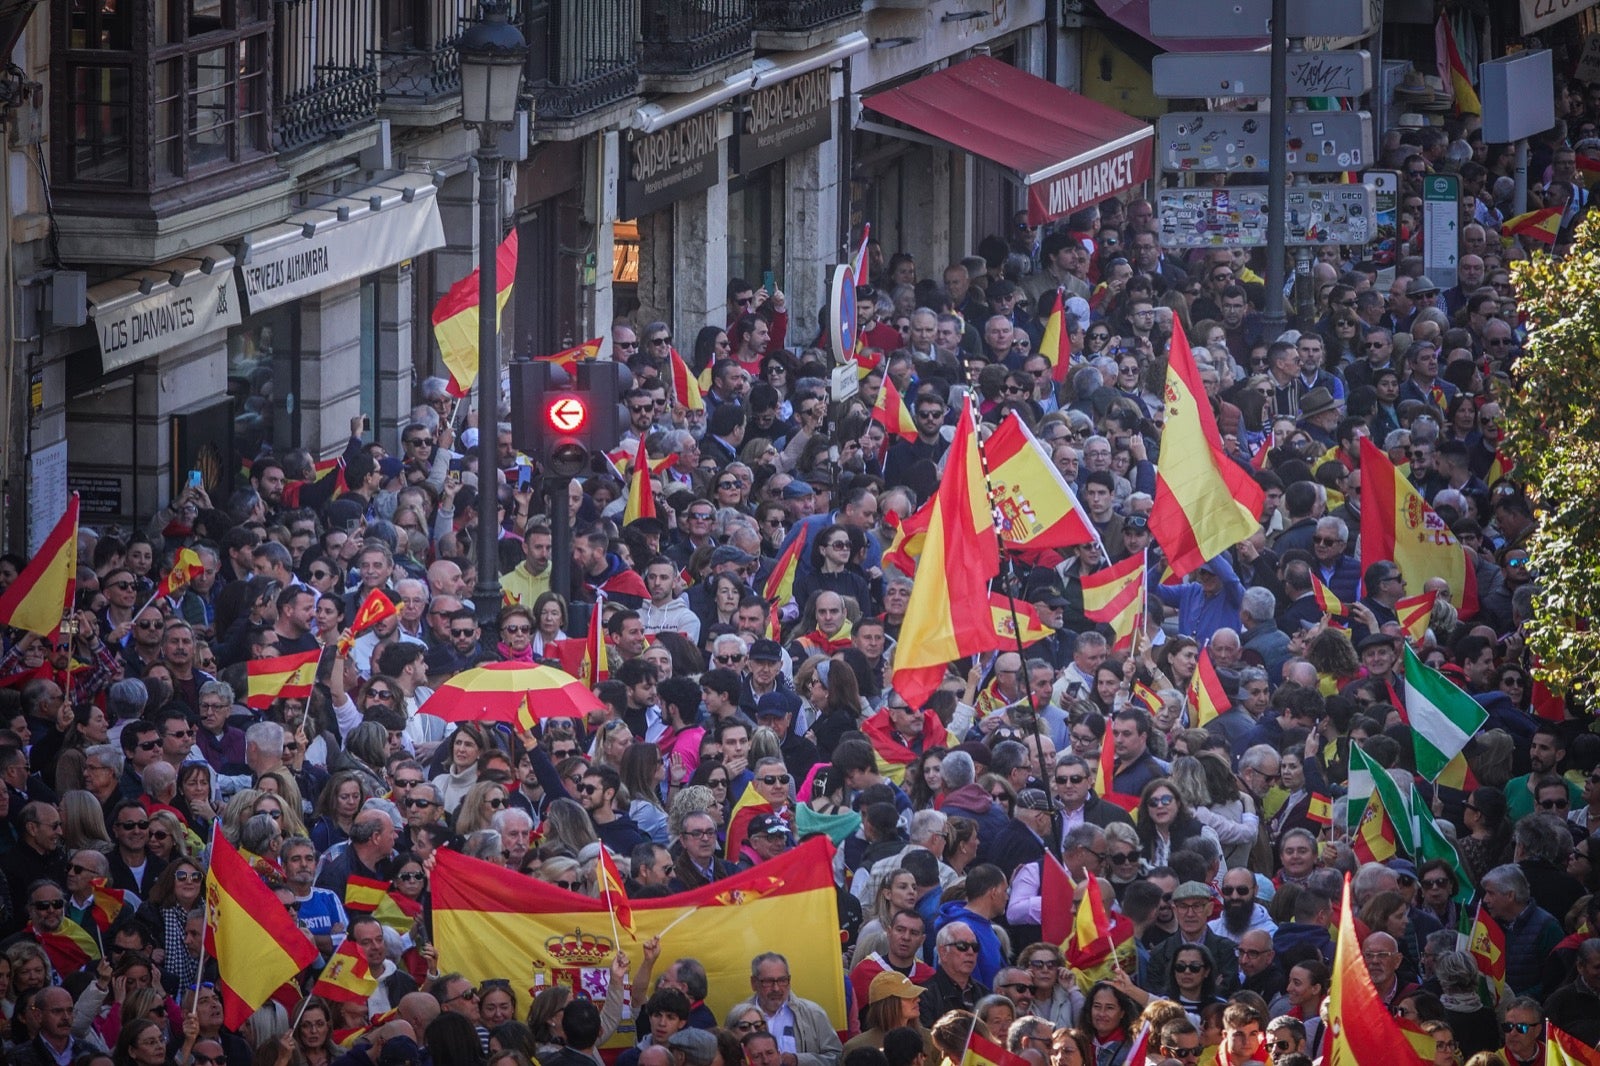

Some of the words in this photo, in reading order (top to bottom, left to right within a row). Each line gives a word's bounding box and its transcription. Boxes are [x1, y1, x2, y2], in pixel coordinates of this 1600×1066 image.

[750, 85, 784, 135] SABOR
[792, 67, 830, 118] ESPAÑA
[636, 128, 672, 182] SABOR
[679, 108, 719, 163] ESPAÑA
[1048, 150, 1133, 215] MINI-MARKET
[246, 258, 284, 297] CERVEZAS
[286, 246, 329, 284] ALHAMBRA
[103, 319, 128, 354] LOS
[132, 296, 195, 344] DIAMANTES
